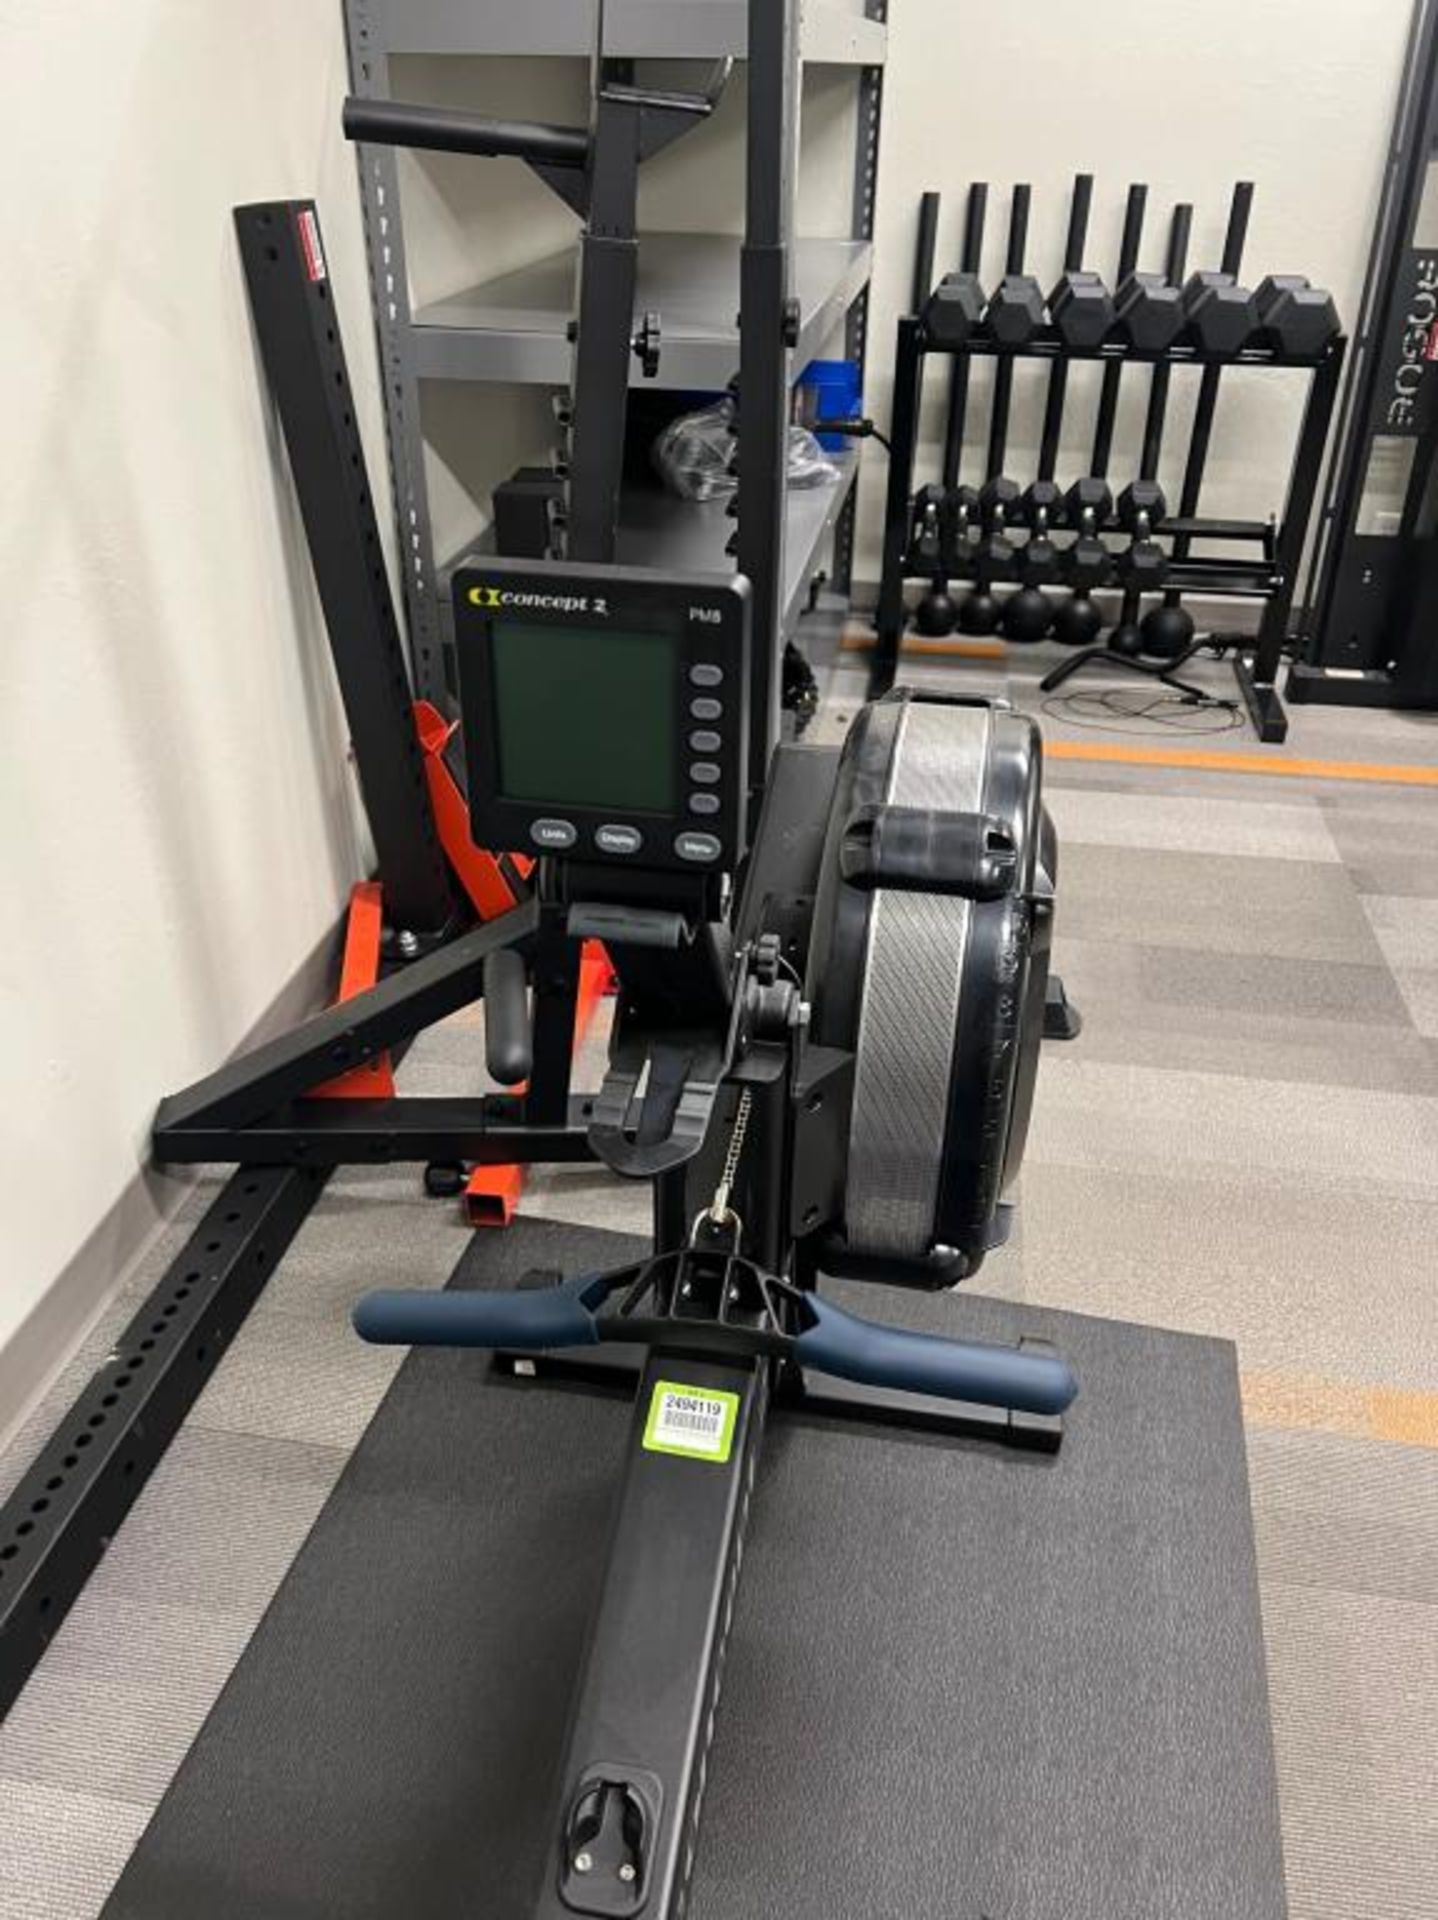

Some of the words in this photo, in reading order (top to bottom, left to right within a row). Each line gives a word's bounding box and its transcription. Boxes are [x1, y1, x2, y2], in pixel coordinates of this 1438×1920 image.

[501, 591, 588, 612] concept
[593, 598, 610, 617] 2
[665, 1394, 721, 1416] 2494119
